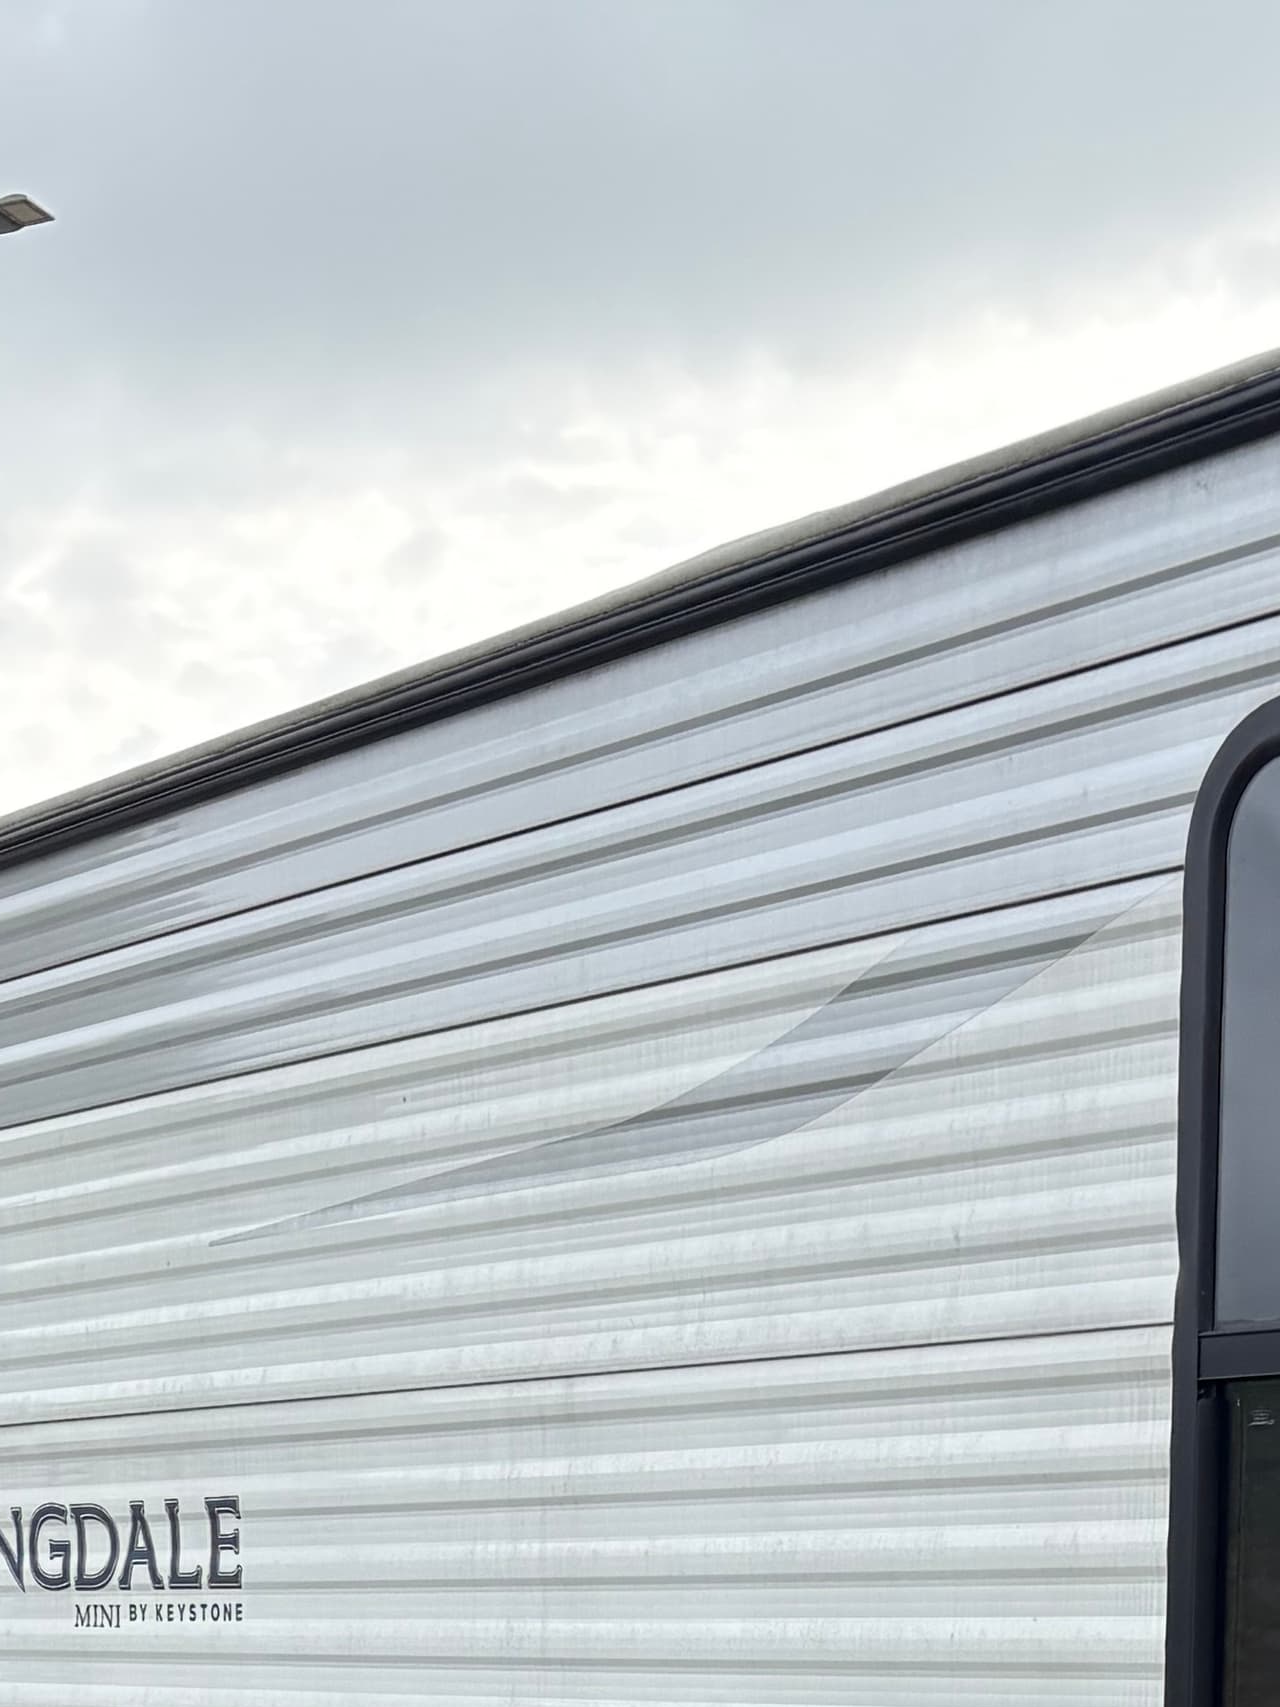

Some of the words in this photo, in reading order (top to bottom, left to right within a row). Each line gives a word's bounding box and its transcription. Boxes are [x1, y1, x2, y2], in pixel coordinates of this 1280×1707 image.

[74, 1604, 121, 1628] MINI
[129, 1603, 148, 1622] BY
[155, 1603, 244, 1621] KEYSTONE
